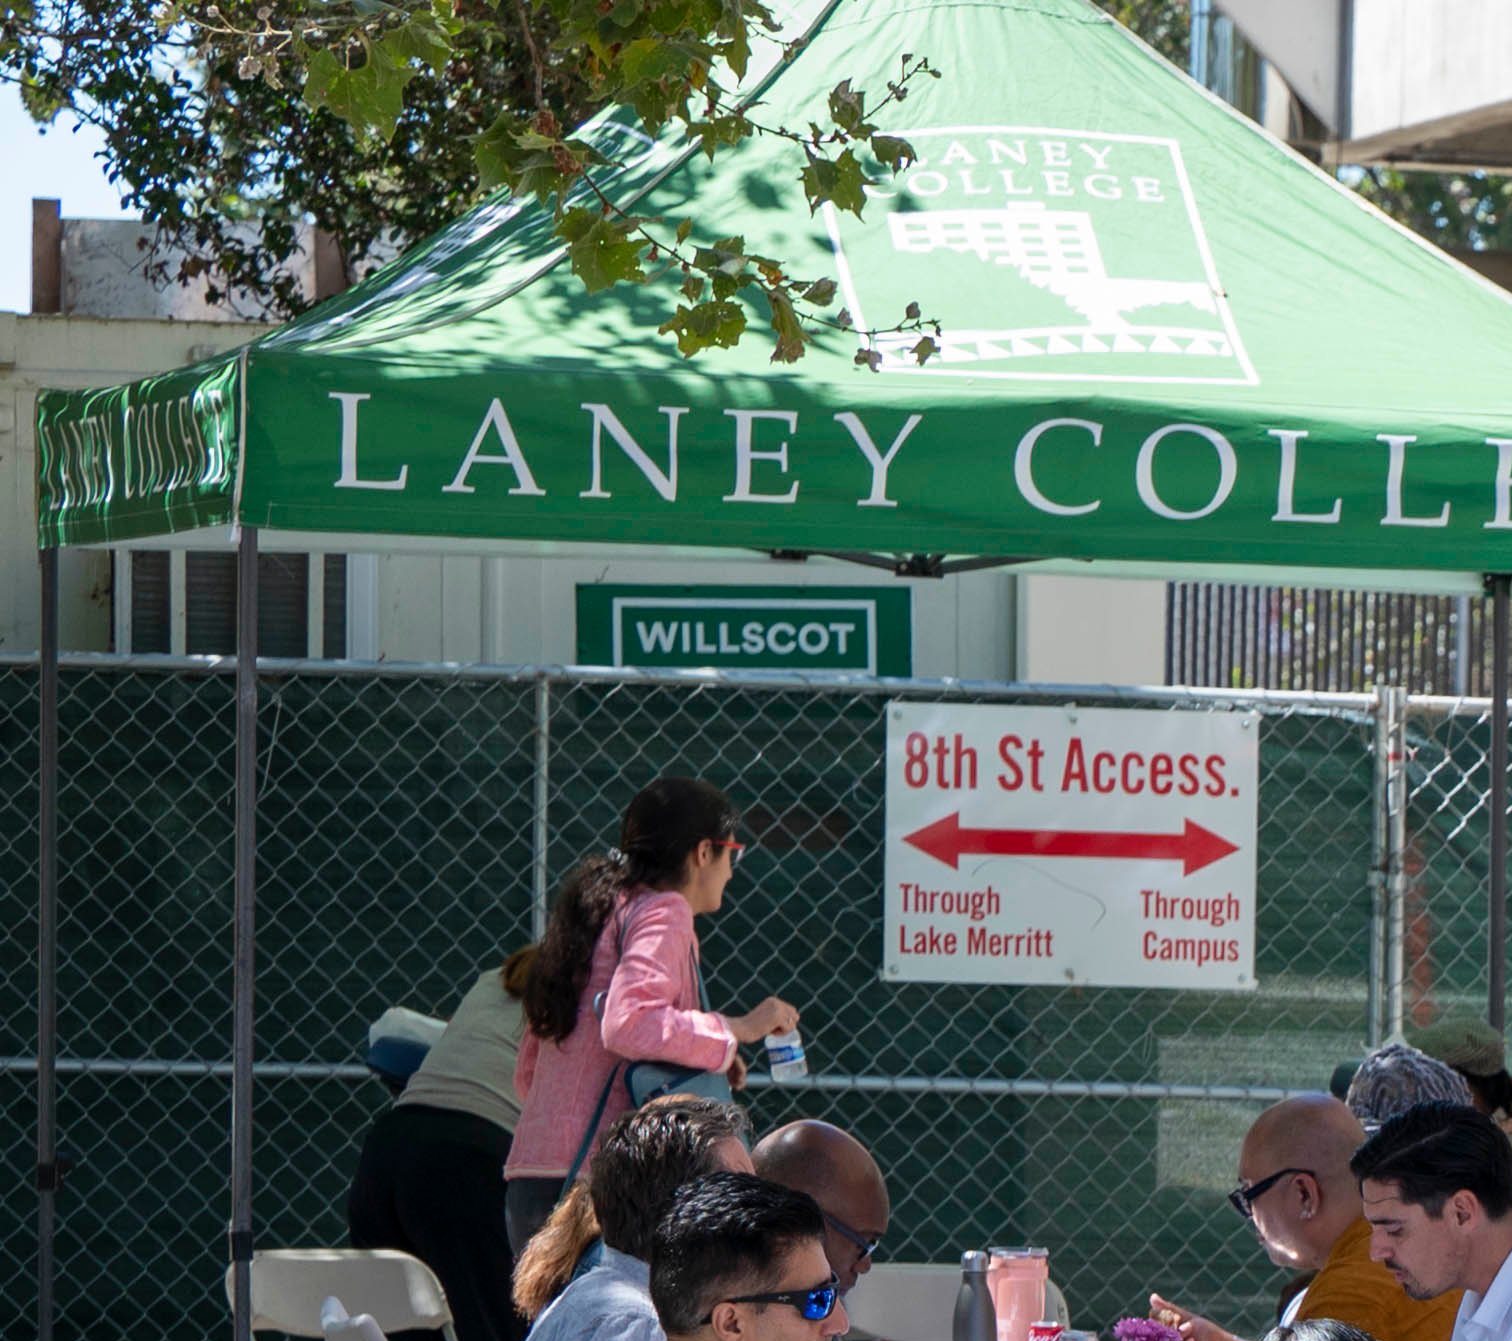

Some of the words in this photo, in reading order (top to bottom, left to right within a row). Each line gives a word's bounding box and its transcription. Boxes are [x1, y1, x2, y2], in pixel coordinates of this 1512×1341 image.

[899, 138, 1113, 170] ANEY
[328, 392, 924, 508] LANEY
[635, 620, 857, 656] WILLSCOT
[904, 731, 979, 790] 8th
[996, 734, 1045, 792] St
[1060, 737, 1240, 798] Access.
[899, 883, 1001, 921] Through
[1139, 889, 1241, 927] Through
[899, 925, 958, 955] Lake
[966, 927, 1054, 958] Merritt
[1142, 930, 1240, 967] Campus
